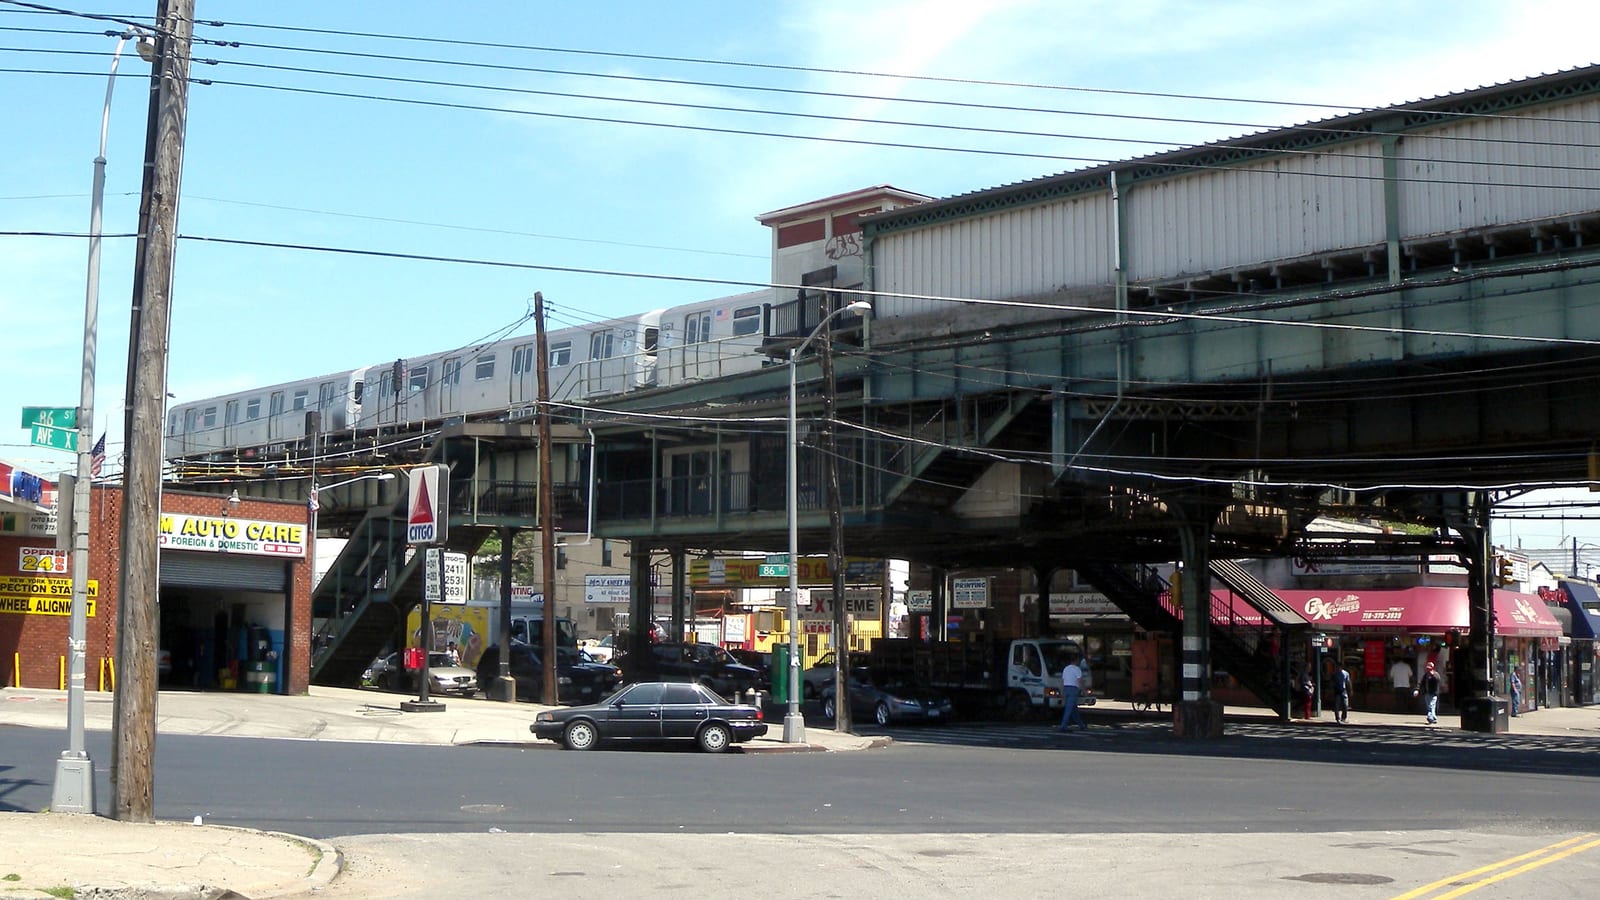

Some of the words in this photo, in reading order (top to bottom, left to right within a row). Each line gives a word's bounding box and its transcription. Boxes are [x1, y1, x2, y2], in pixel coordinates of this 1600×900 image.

[39, 410, 54, 426] 86
[64, 410, 74, 420] ST
[36, 426, 53, 446] AVE
[65, 431, 72, 449] X
[180, 518, 240, 539] AUTO
[245, 522, 302, 544] CARE
[410, 524, 433, 540] CITGO
[171, 536, 207, 547] FOREIGN
[209, 539, 215, 548] &
[218, 540, 259, 551] DOMESTIC
[22, 555, 54, 571] 24
[445, 565, 459, 574] 241
[763, 566, 775, 575] 86
[445, 576, 460, 585] 253
[445, 587, 460, 596] 263
[0, 598, 32, 611] WHEEL
[36, 600, 93, 614] ALIGNMT
[805, 599, 875, 613] EXTEME
